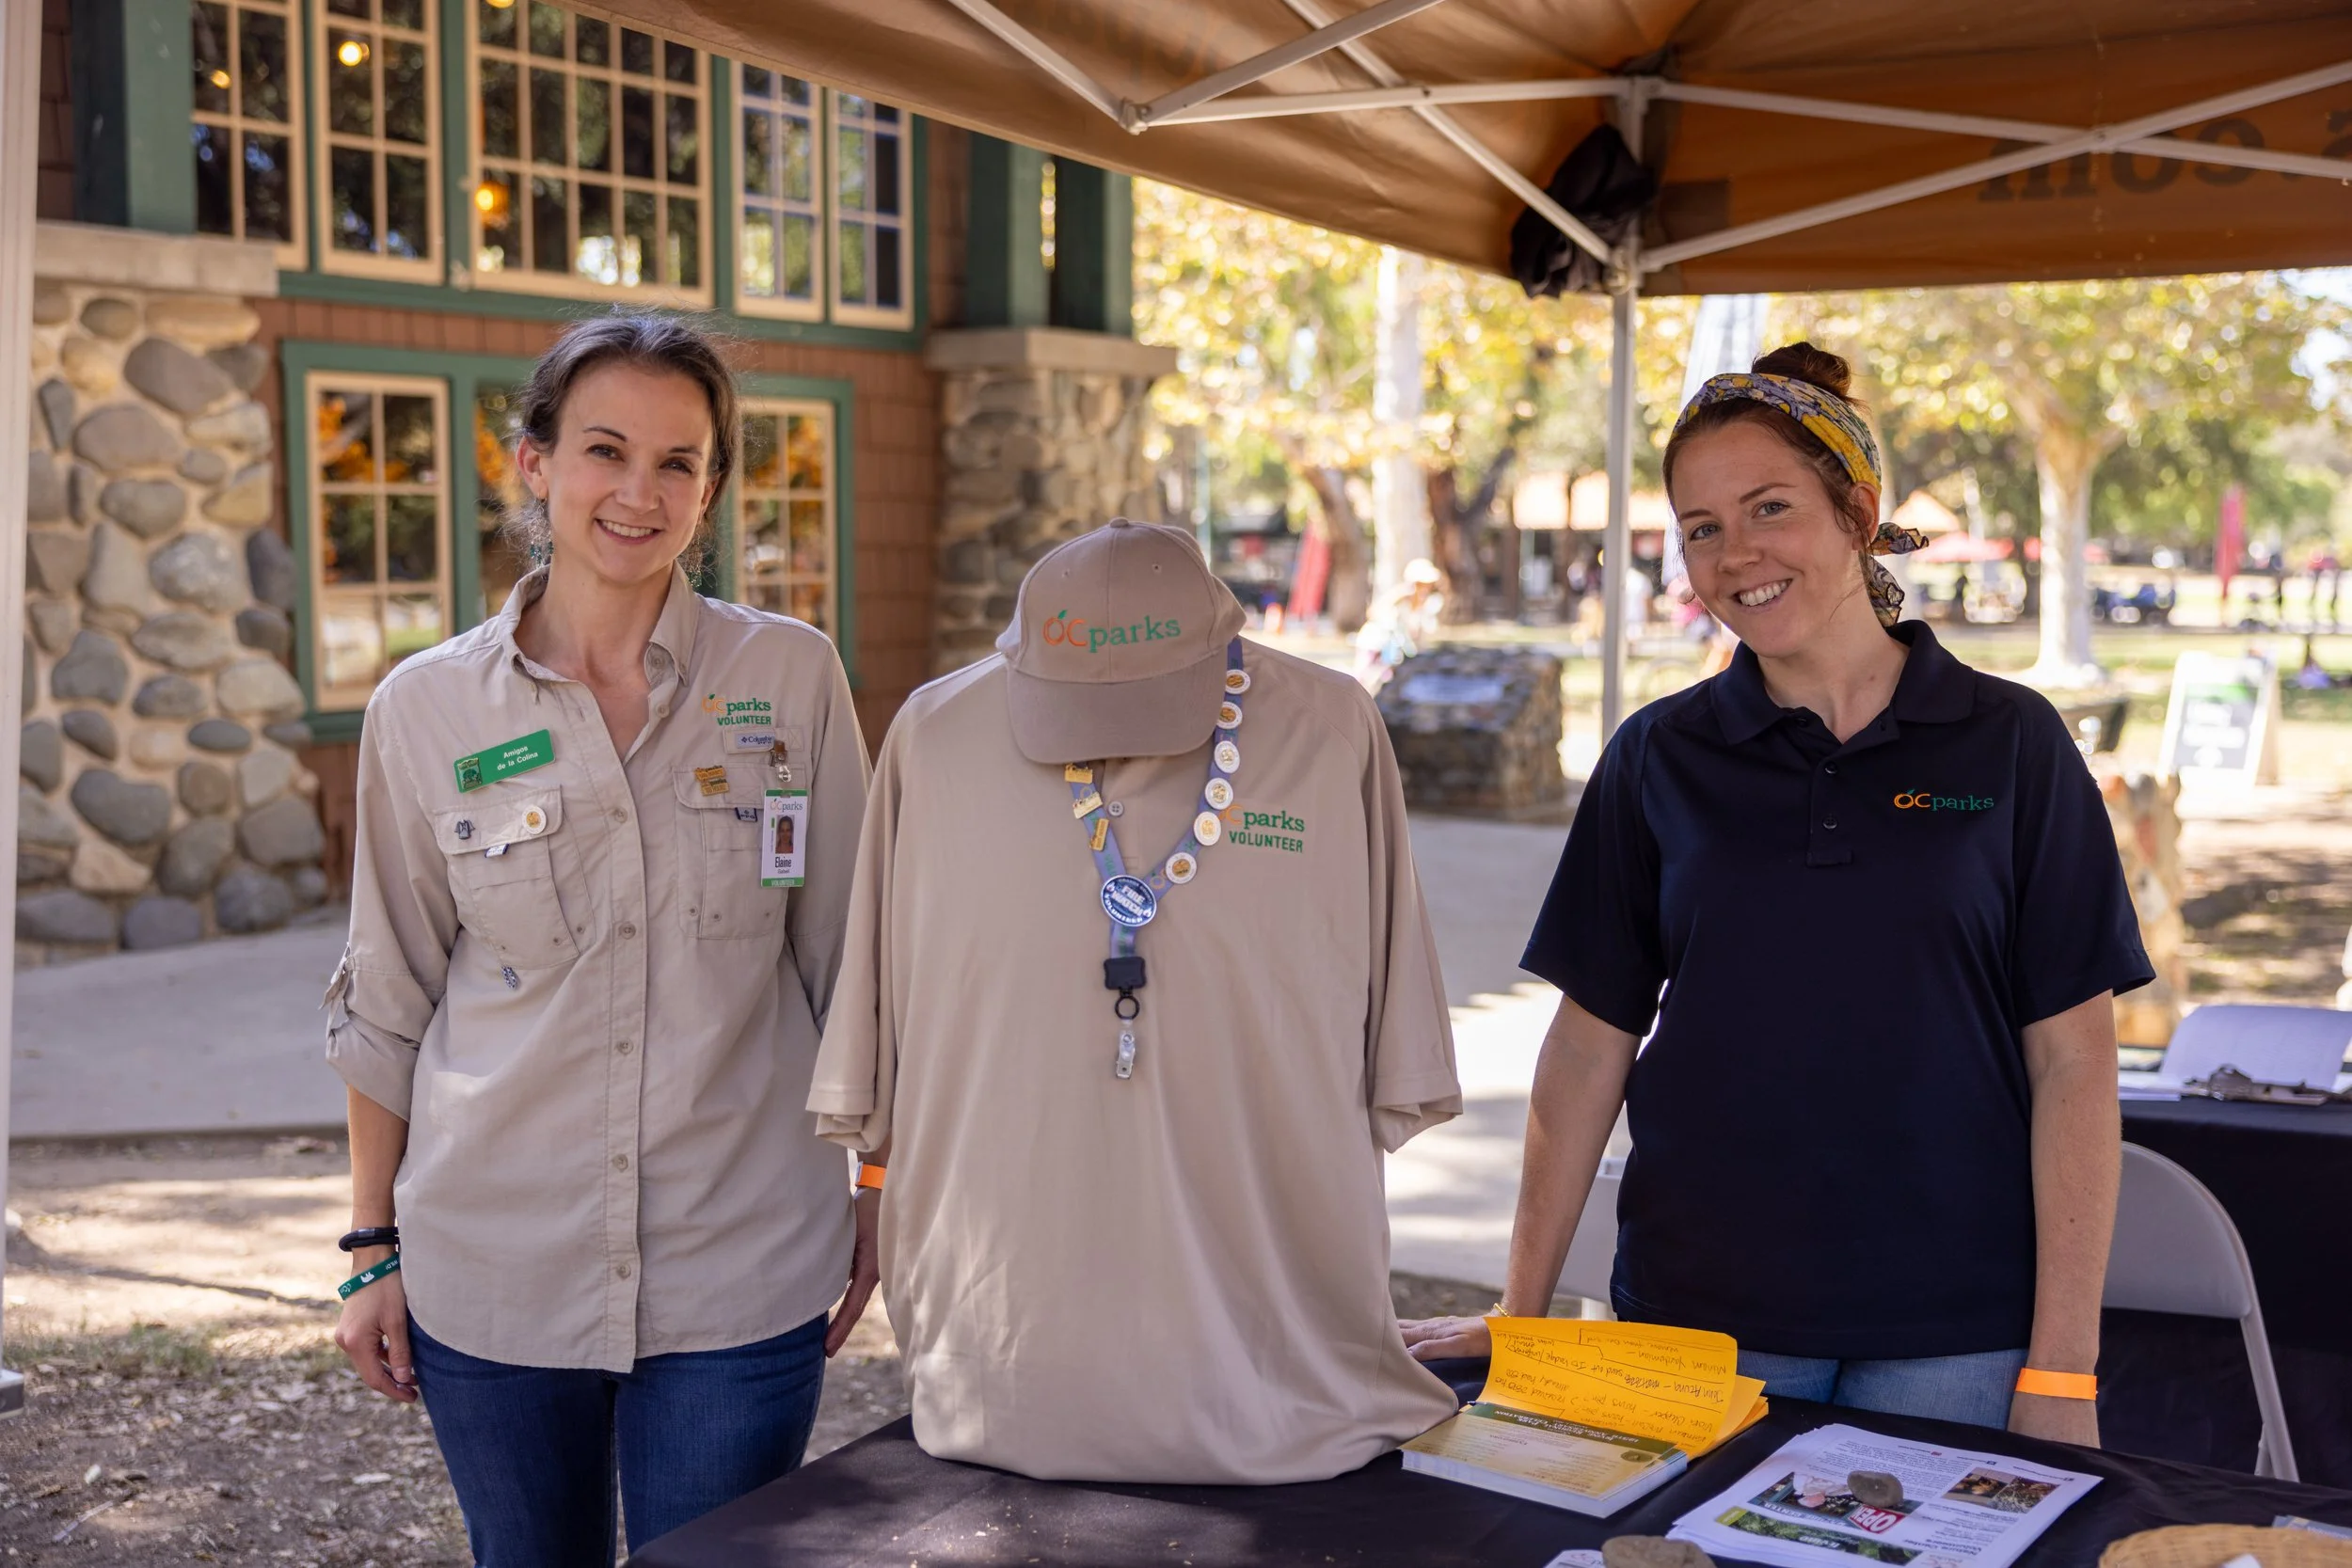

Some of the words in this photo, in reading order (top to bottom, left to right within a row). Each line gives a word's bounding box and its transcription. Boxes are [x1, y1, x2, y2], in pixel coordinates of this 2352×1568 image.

[1043, 611, 1182, 653] OCparks
[701, 694, 771, 715] OCparks
[717, 715, 771, 726] VOLUNTEER
[497, 763, 506, 771] de
[516, 752, 538, 764] Colina
[503, 746, 529, 759] Amigos
[1894, 788, 1994, 812] OCparks
[1218, 805, 1305, 832] Cparks
[1228, 831, 1304, 853] VOLUNTEER
[774, 856, 792, 868] Elaine
[1850, 1506, 1897, 1532] OPEN
